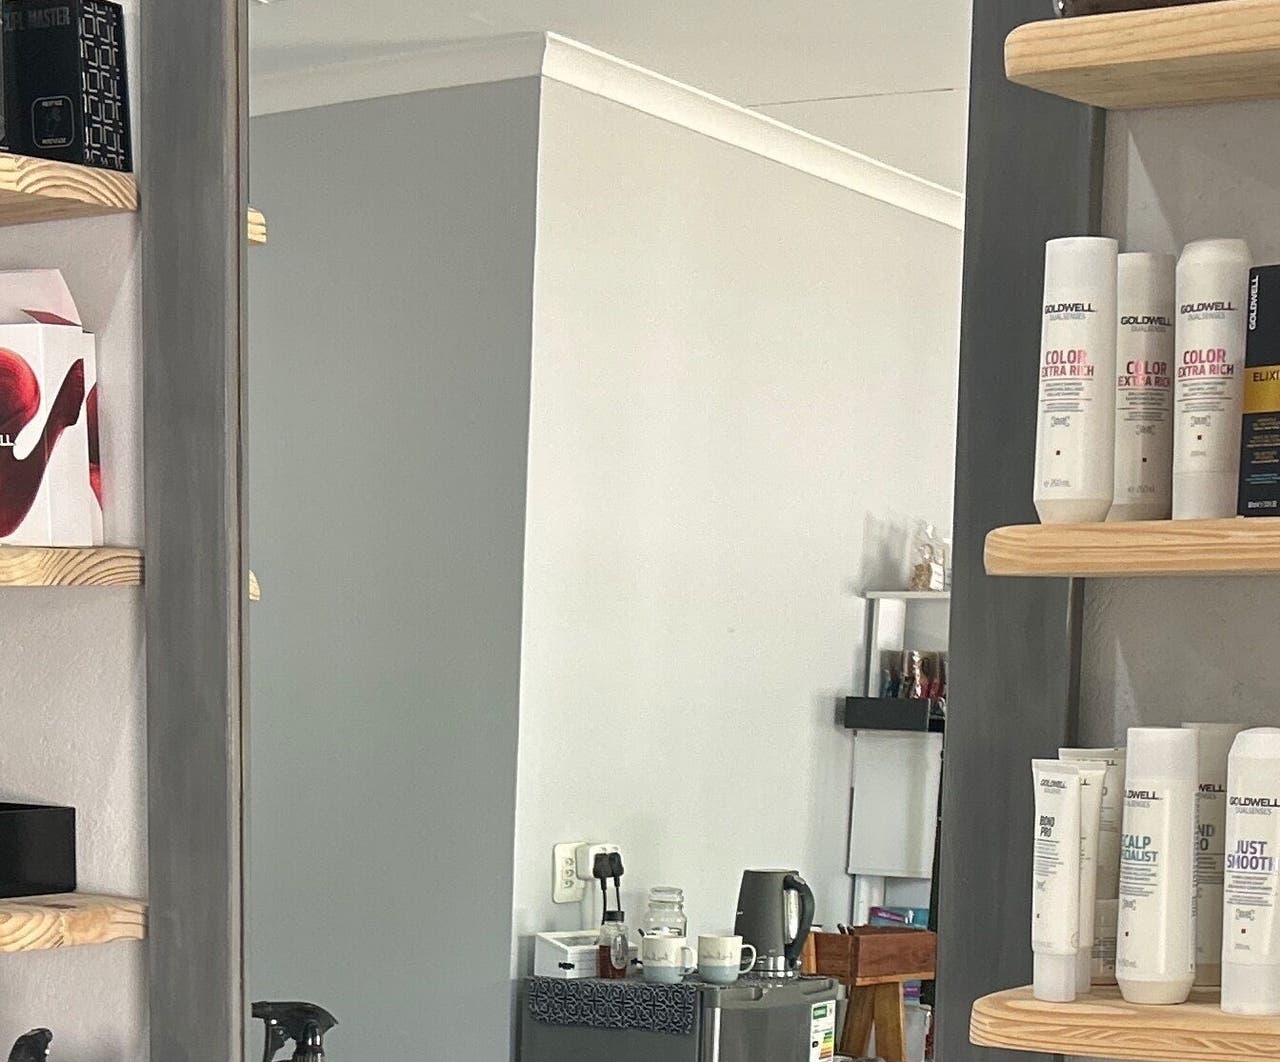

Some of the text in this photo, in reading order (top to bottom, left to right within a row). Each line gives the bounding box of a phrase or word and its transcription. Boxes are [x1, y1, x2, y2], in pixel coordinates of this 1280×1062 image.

[1045, 303, 1096, 313] GOLDWELL
[1181, 302, 1236, 314] GOLDWELL
[1249, 275, 1259, 331] GOLDWELL
[1120, 316, 1172, 327] GOLDWELL
[1046, 350, 1087, 366] COLOR
[1183, 349, 1226, 365] COLOR
[1041, 365, 1095, 378] EXTRA RICH
[1126, 361, 1167, 376] COLOR
[1178, 363, 1234, 378] EXTRA RICH
[1118, 376, 1151, 387] EXTRA
[1198, 784, 1227, 792] WELL
[1040, 816, 1055, 828] BOND
[1040, 827, 1052, 838] PRO
[1236, 840, 1268, 855] JUST
[1227, 854, 1277, 871] SMOOTH
